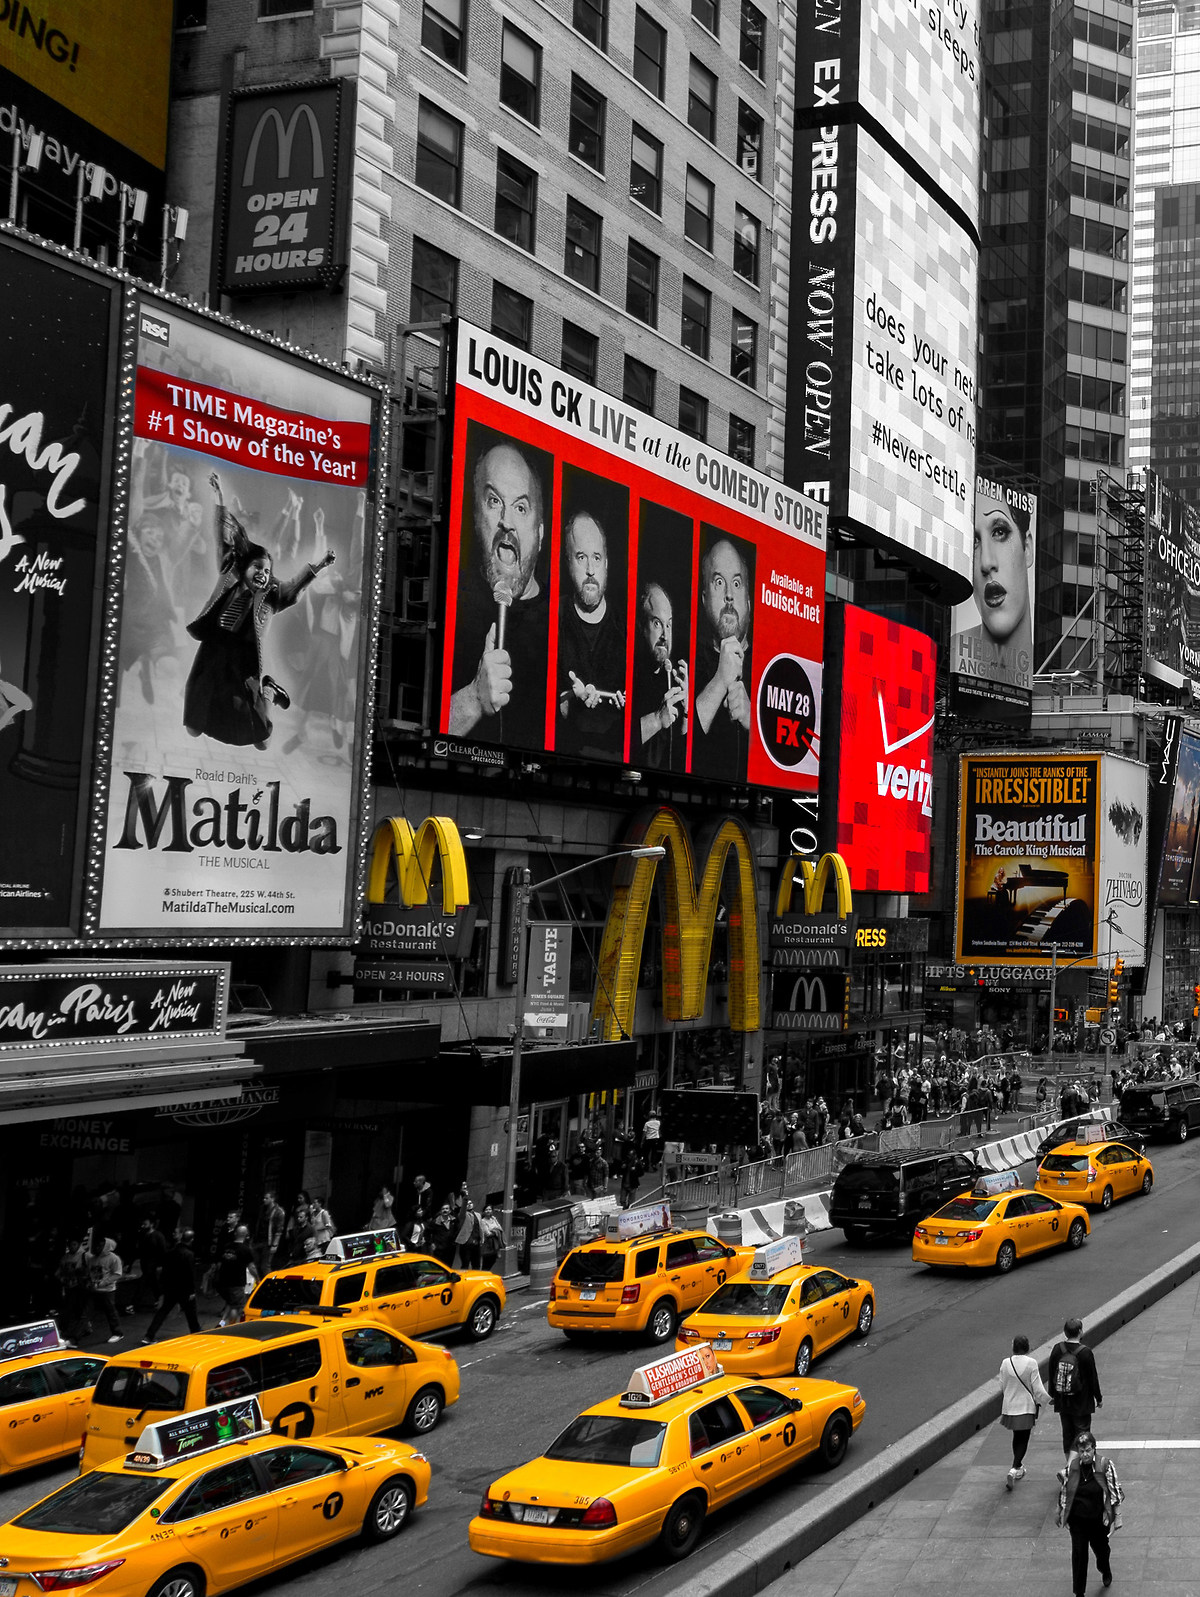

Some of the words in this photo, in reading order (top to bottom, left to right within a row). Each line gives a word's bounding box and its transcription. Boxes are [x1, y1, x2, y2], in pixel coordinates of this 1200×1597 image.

[247, 188, 319, 213] OPEN
[253, 212, 309, 248] 24
[235, 248, 325, 274] HOURS
[806, 261, 836, 356] NOW
[142, 318, 169, 340] RSC
[866, 292, 906, 345] does
[912, 333, 949, 376] your
[866, 340, 904, 391] take
[911, 368, 943, 419] lots
[948, 406, 964, 432] of
[167, 383, 228, 420] TIME
[234, 402, 341, 450] Magazine’s
[804, 360, 834, 460] OPEN
[147, 409, 176, 438] #1
[183, 418, 242, 453] Show
[248, 437, 270, 457] of
[274, 443, 305, 468] the
[310, 450, 357, 481] Year!
[468, 337, 543, 407] LOUIS
[551, 380, 583, 428] CK
[589, 398, 638, 453] LIVE
[642, 435, 662, 459] at
[665, 441, 692, 473] the
[695, 453, 770, 514] COMEDY
[774, 491, 823, 541] STORE
[873, 419, 966, 502] #NeverSettle
[1005, 486, 1034, 515] CRISS
[14, 554, 29, 573] A
[28, 551, 64, 574] New
[1158, 534, 1190, 582] OFFICE
[13, 572, 67, 596] Musical
[770, 569, 803, 595] Available
[804, 585, 814, 599] at
[761, 582, 821, 624] louisck.net
[766, 685, 794, 713] MAY
[795, 692, 811, 718] 28
[776, 715, 802, 749] FX
[1010, 767, 1029, 780] JOINS
[1030, 767, 1042, 780] THE
[1043, 767, 1065, 780] RANKS
[1066, 767, 1076, 780] OF
[1077, 766, 1089, 779] THE
[112, 771, 343, 855] Matilda
[974, 813, 1088, 843] Beautiful
[199, 854, 220, 869] THE
[223, 856, 270, 870] MUSICAL
[974, 843, 993, 856] The
[994, 843, 1025, 857] Carole
[1026, 844, 1048, 859] King
[1049, 844, 1086, 857] Musical
[172, 888, 203, 898] Shubert
[240, 890, 256, 899] 225
[1104, 878, 1144, 907] ZHIVAGO
[162, 900, 296, 914] MatildaTheMusical.com
[772, 923, 848, 936] McDonald's
[784, 936, 834, 945] Restaurant
[370, 938, 438, 950] Restaurant
[543, 928, 558, 987] TASTE
[356, 969, 387, 981] OPEN
[389, 971, 404, 981] 24
[406, 971, 446, 983] HOURS
[150, 988, 165, 1010] A
[163, 979, 198, 1008] New
[60, 983, 139, 1034] Paris
[149, 1000, 201, 1031] Musical
[54, 1119, 113, 1135] MONEY
[40, 1133, 130, 1152] EXCHANGE
[18, 1335, 44, 1347] friendly
[646, 1350, 701, 1384] FLASHDANCERS
[687, 1363, 702, 1379] CLUB
[364, 1385, 385, 1400] NYC
[628, 1392, 643, 1402] 1G29
[658, 1386, 671, 1398] 52ND
[676, 1375, 699, 1392] BROADWAY
[169, 1430, 179, 1440] ALL
[178, 1426, 190, 1437] HAIL
[190, 1424, 201, 1434] THE
[200, 1421, 209, 1431] CAB
[133, 1454, 151, 1464] 4N39
[573, 1496, 590, 1506] 385
